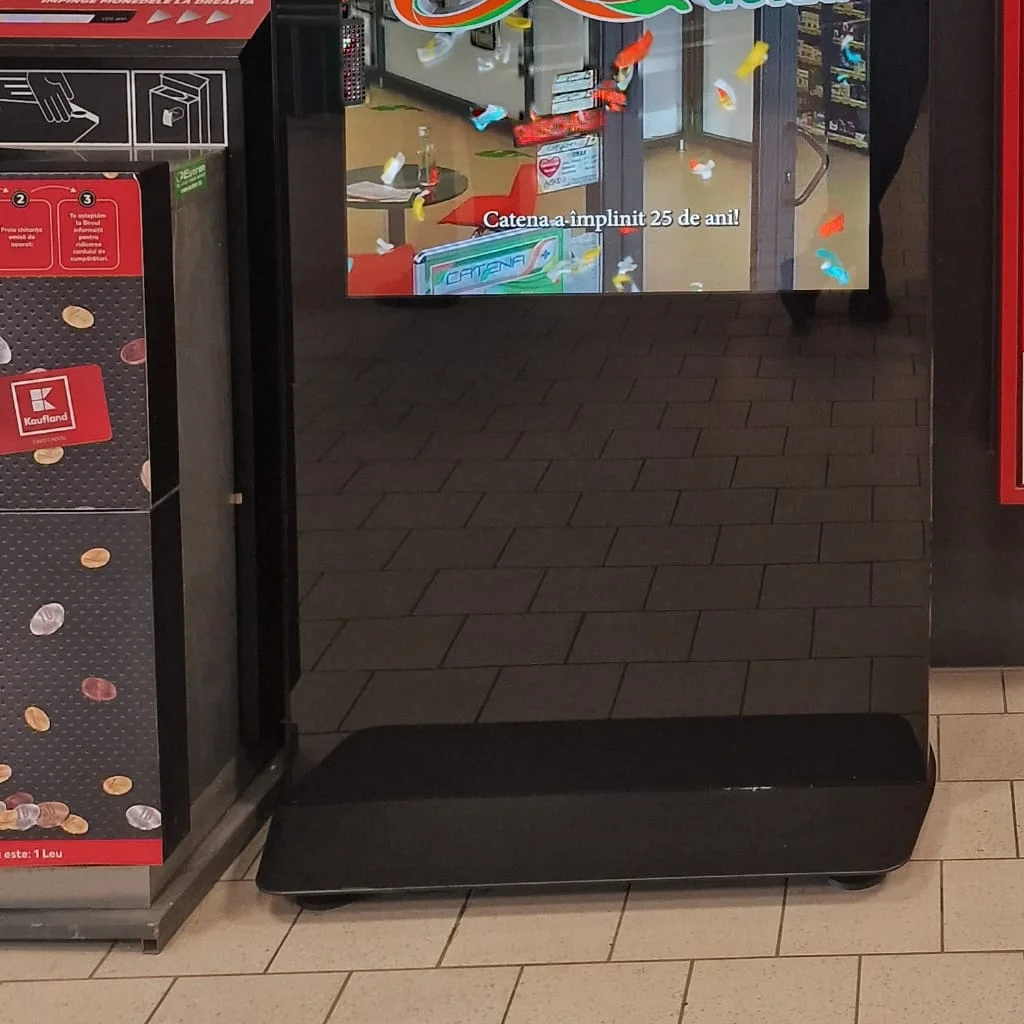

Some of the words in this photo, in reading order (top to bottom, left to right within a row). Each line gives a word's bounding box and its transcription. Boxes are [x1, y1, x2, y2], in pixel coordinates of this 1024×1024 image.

[17, 192, 26, 205] 2
[83, 192, 92, 205] 3
[483, 211, 550, 229] Catena
[554, 216, 566, 228] a
[570, 209, 646, 232] împlinit
[650, 211, 674, 228] 25
[678, 210, 700, 227] de
[705, 209, 740, 227] ani!
[24, 412, 68, 426] Kaufland
[4, 849, 32, 860] este:
[34, 849, 40, 859] 1
[42, 849, 63, 859] Leu
